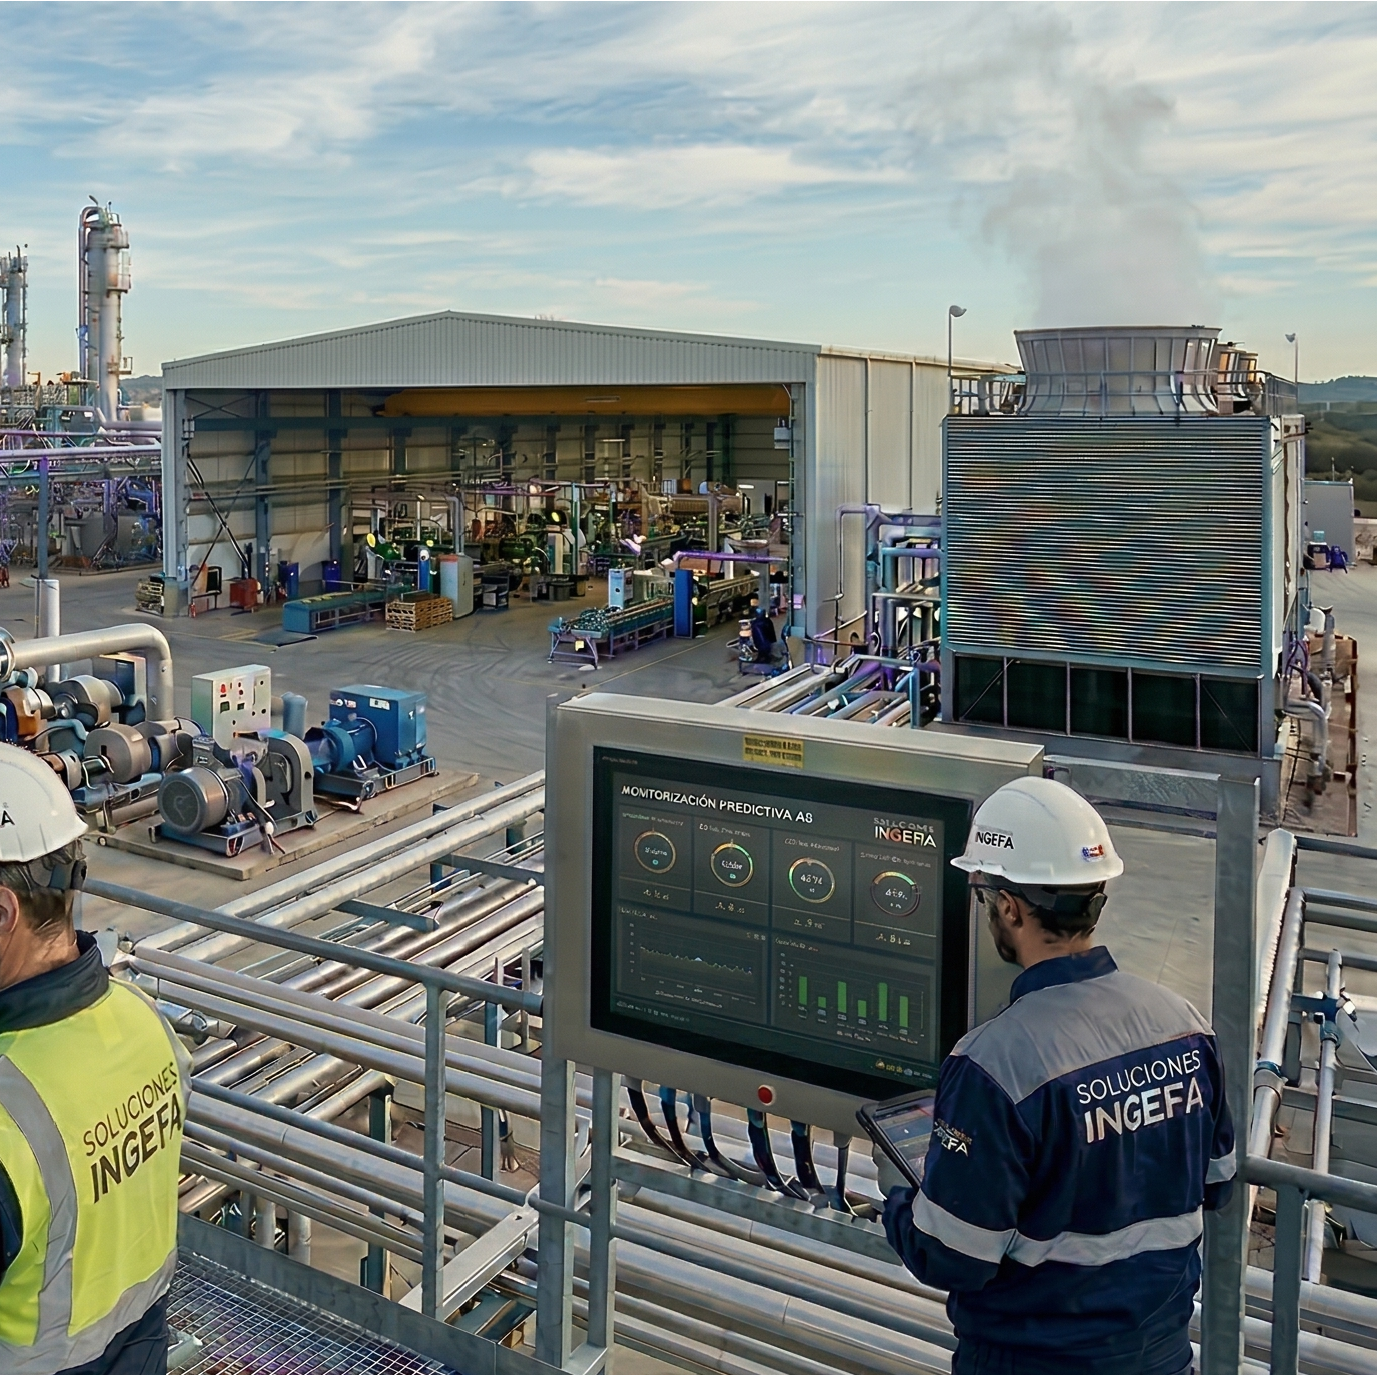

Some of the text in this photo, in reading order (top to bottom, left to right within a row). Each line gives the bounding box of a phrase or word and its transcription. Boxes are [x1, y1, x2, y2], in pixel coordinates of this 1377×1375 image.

[719, 799, 792, 821] PREDICTIVA
[83, 1061, 177, 1157] SOLUCIONES
[1076, 1049, 1201, 1104] SOLUCIONES
[1084, 1076, 1204, 1144] INGEFA
[90, 1092, 182, 1204] INGEFA
